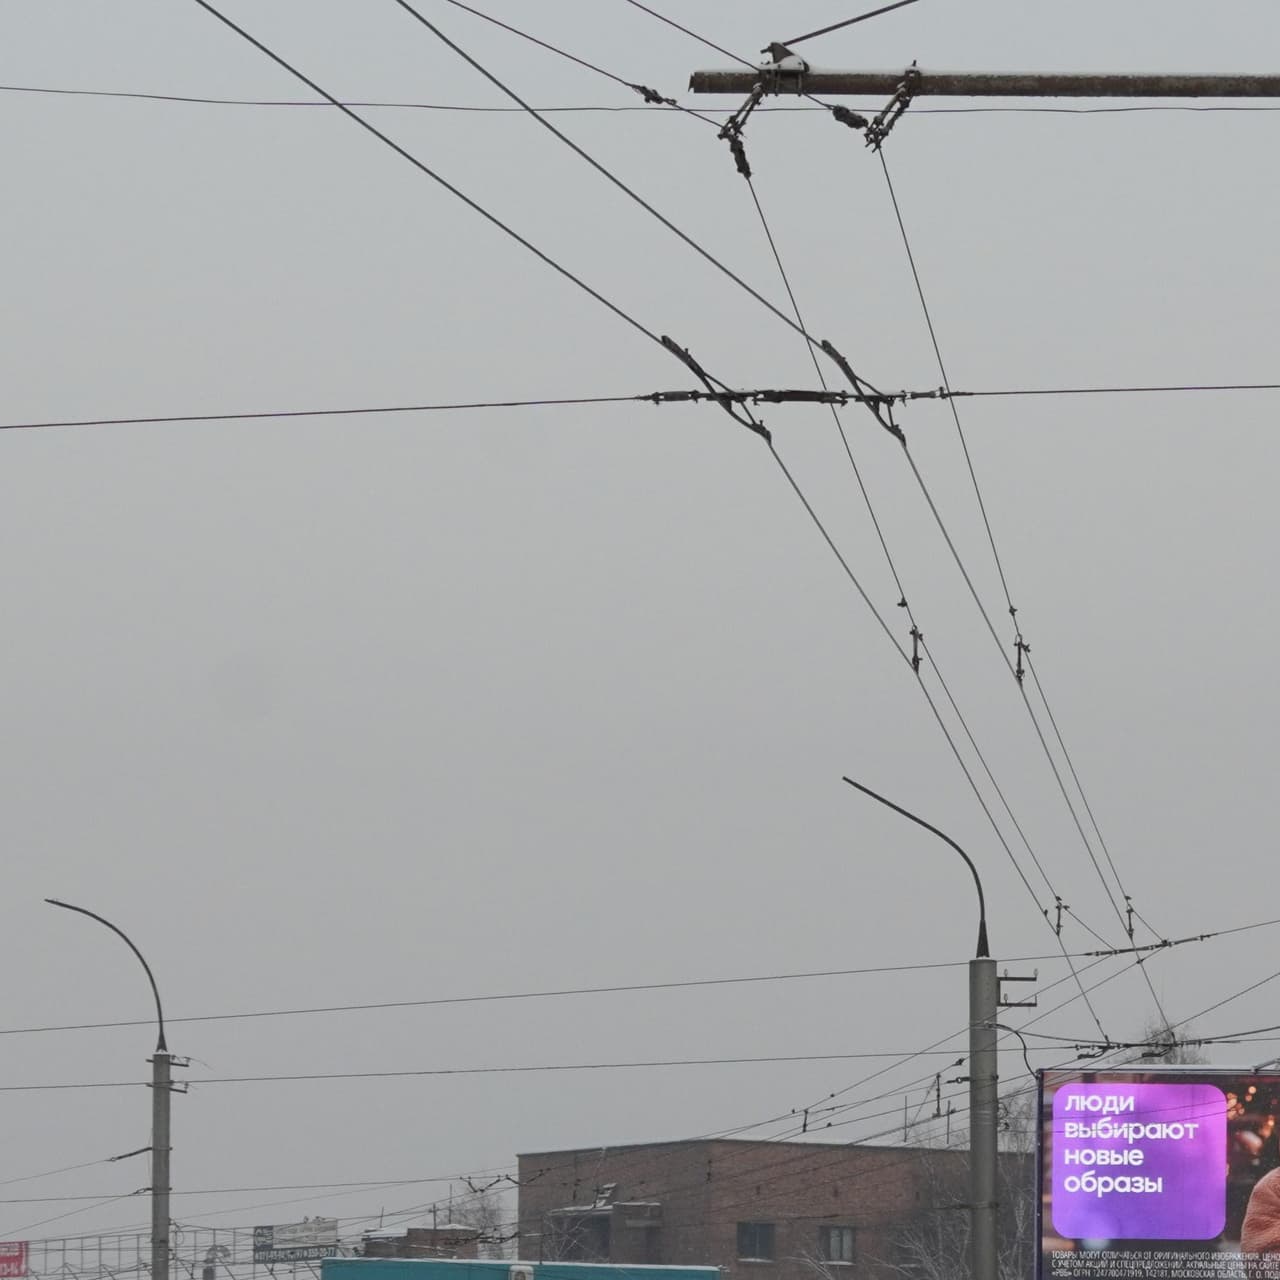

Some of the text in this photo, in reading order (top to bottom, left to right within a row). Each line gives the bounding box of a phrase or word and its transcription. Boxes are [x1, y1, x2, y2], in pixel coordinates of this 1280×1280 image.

[1064, 1095, 1135, 1115] люди
[1064, 1117, 1199, 1144] выбирают
[1064, 1148, 1144, 1166] новые
[1064, 1170, 1163, 1198] образы
[1079, 1251, 1100, 1260] МОГУТ
[1171, 1270, 1216, 1279] МОСКОВСКАЯ
